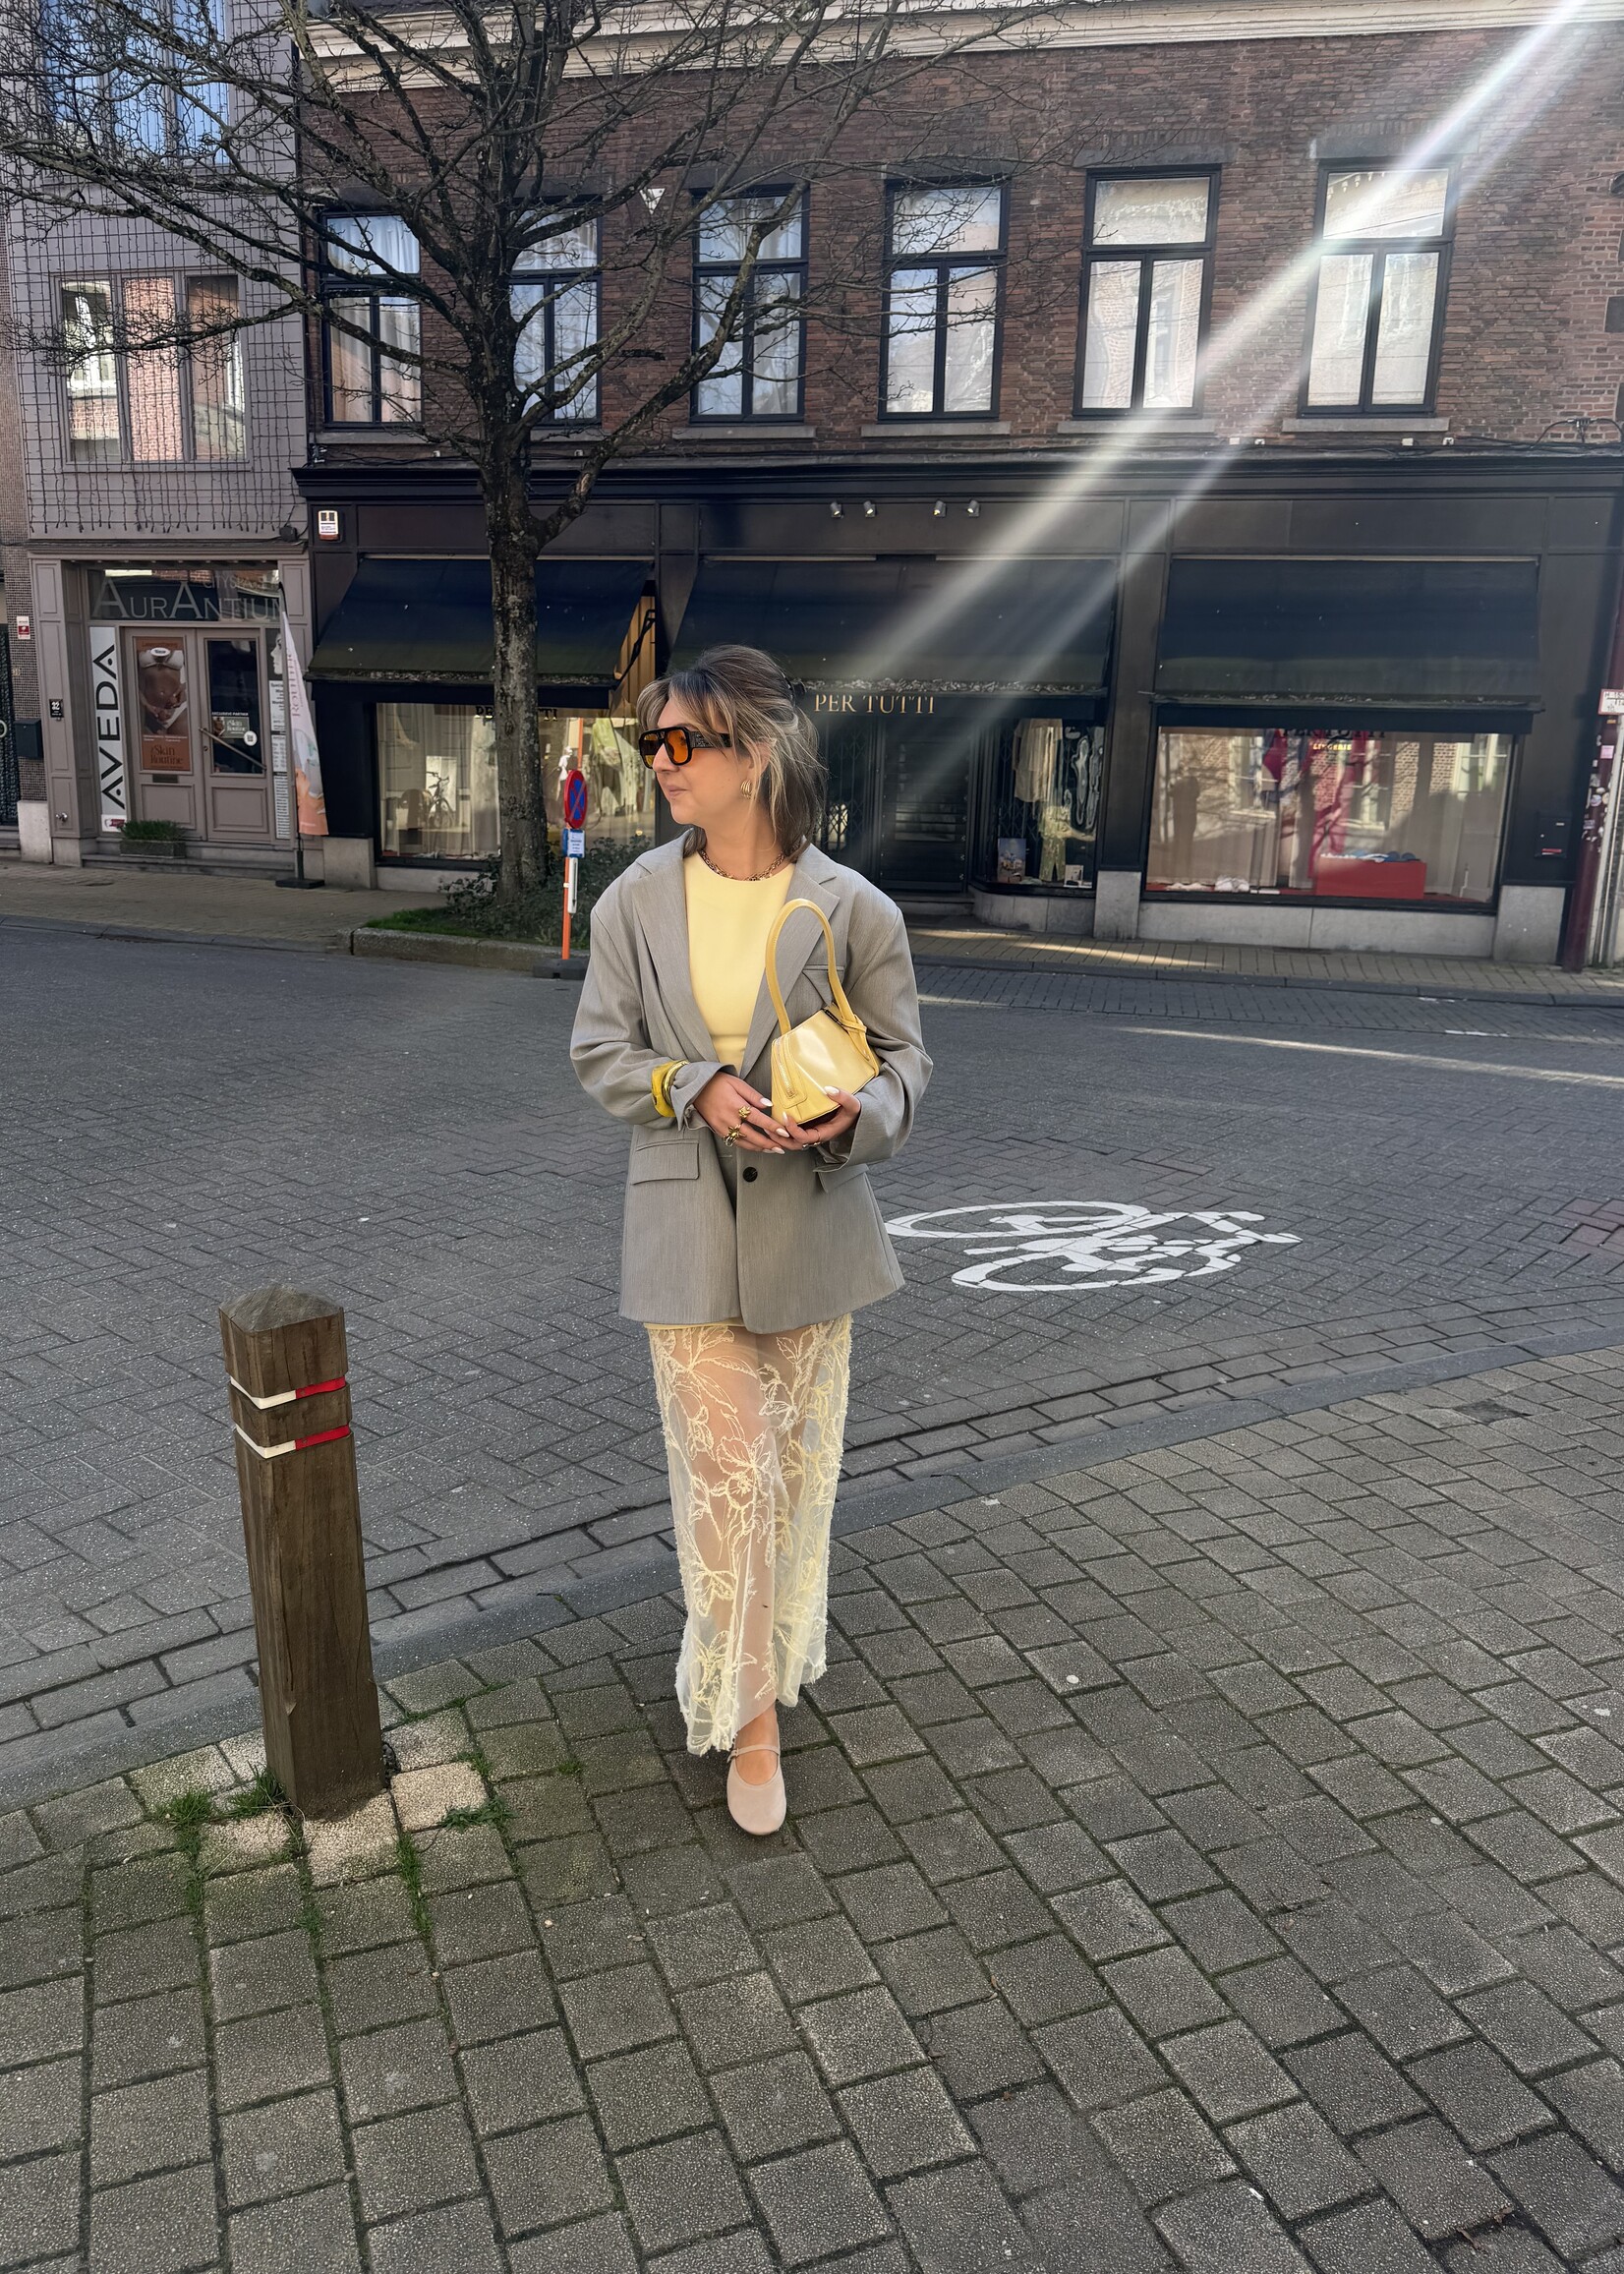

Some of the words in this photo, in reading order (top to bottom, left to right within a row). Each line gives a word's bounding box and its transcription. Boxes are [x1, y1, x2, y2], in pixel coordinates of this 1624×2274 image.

[474, 706, 495, 719] PE
[814, 694, 857, 713] PER
[862, 694, 937, 714] TUTTI
[92, 644, 125, 810] AVEDA
